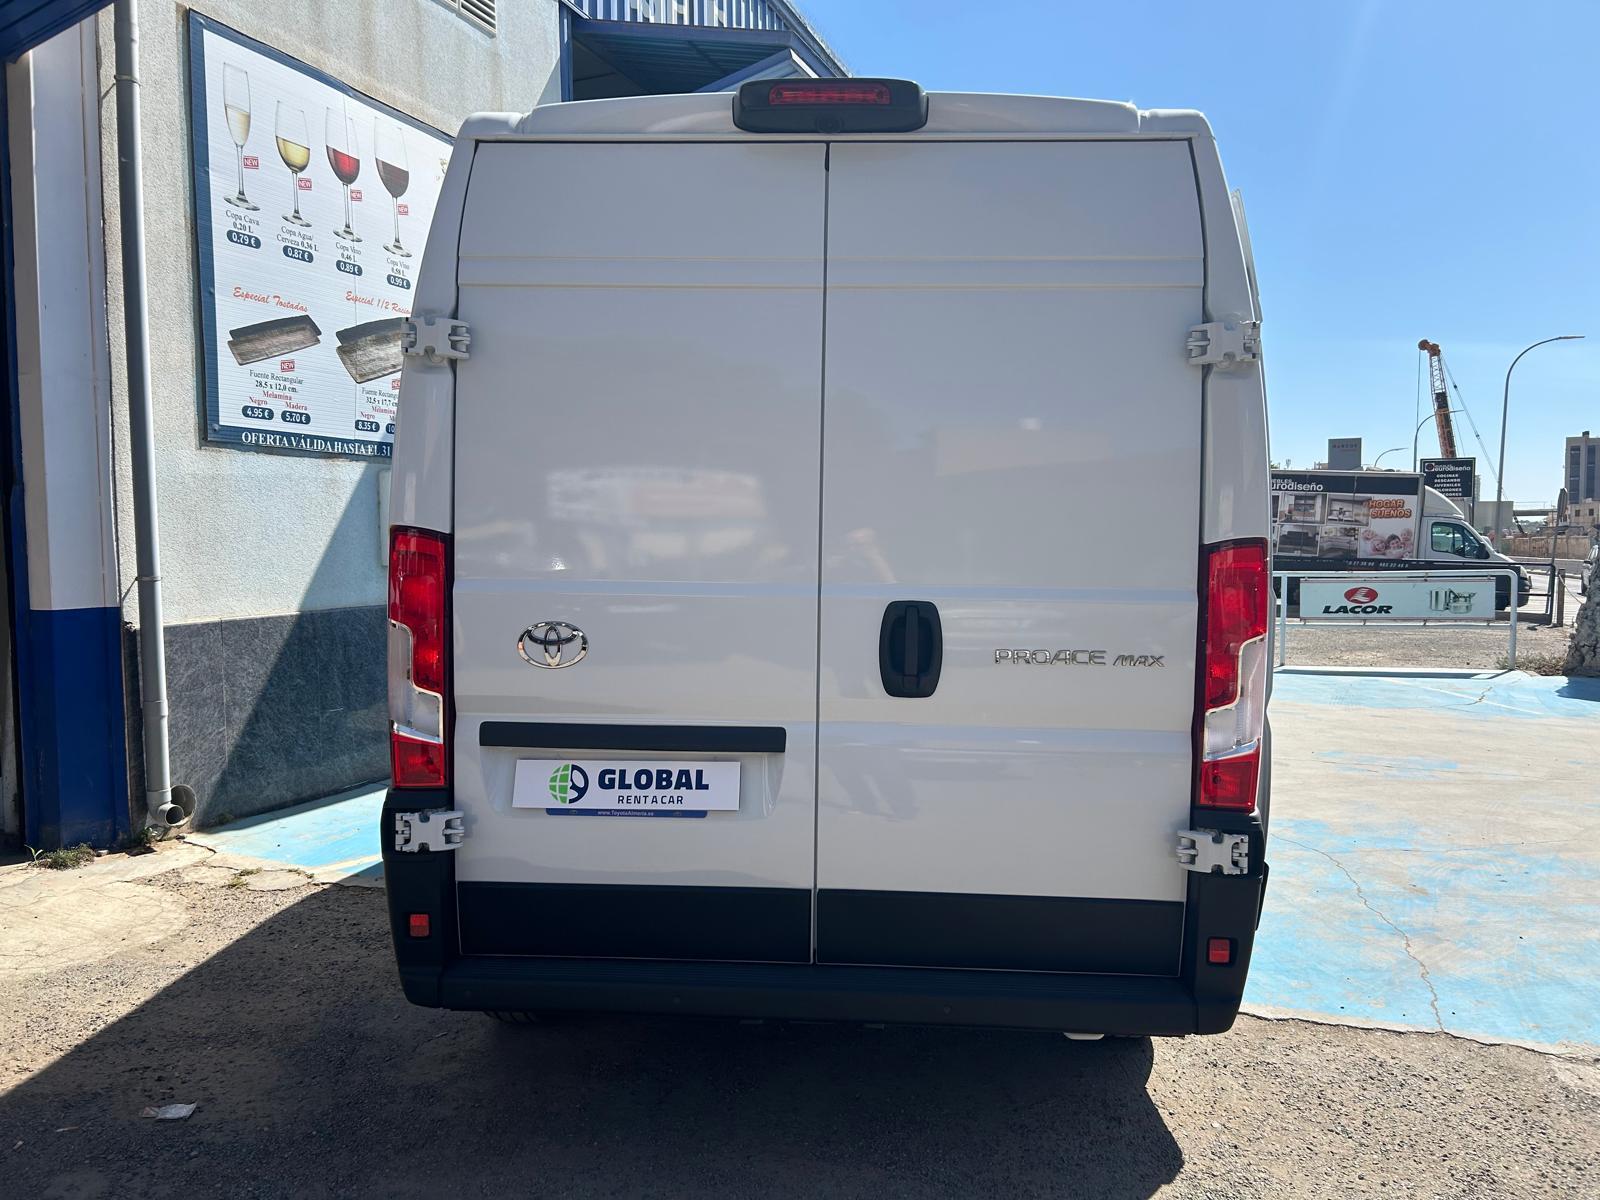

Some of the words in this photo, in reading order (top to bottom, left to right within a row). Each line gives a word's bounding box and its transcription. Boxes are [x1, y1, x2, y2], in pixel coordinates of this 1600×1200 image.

[244, 158, 258, 166] NEW
[299, 180, 312, 188] NEW
[226, 210, 243, 221] Copa
[244, 215, 260, 226] Cava
[281, 226, 297, 236] Copa
[232, 233, 249, 244] 0.79
[277, 234, 300, 246] Cerveza
[336, 242, 350, 252] Copa
[350, 246, 362, 255] Vino
[287, 248, 302, 260] 0.87
[340, 263, 354, 273] 0.89
[390, 277, 402, 287] 0.99
[233, 287, 269, 303] Especial
[273, 295, 308, 312] Tostadas
[346, 291, 374, 306] Especial
[376, 298, 390, 310] 1/2
[281, 361, 295, 370] NEW
[249, 369, 269, 379] Fuente
[270, 372, 304, 385] Rectangular
[262, 390, 293, 401] Melamina
[378, 389, 398, 400] Rectang
[249, 396, 268, 406] Negro
[285, 401, 308, 411] Madera
[246, 408, 263, 418] 4.95
[285, 412, 300, 422] 5.70
[360, 411, 376, 420] Negro
[358, 422, 371, 430] 8.35
[241, 431, 289, 446] OFERTA
[291, 434, 333, 452] VÁLIDA
[334, 441, 368, 454] HASTA
[369, 444, 380, 456] EL
[1434, 464, 1471, 472] eurodiseño
[1272, 482, 1324, 492] urodiseño
[1369, 499, 1405, 509] HOGAR
[1322, 605, 1393, 614] LACOR
[994, 648, 1107, 665] PROACE
[1112, 654, 1165, 668] MAX
[597, 768, 710, 791] GLOBAL
